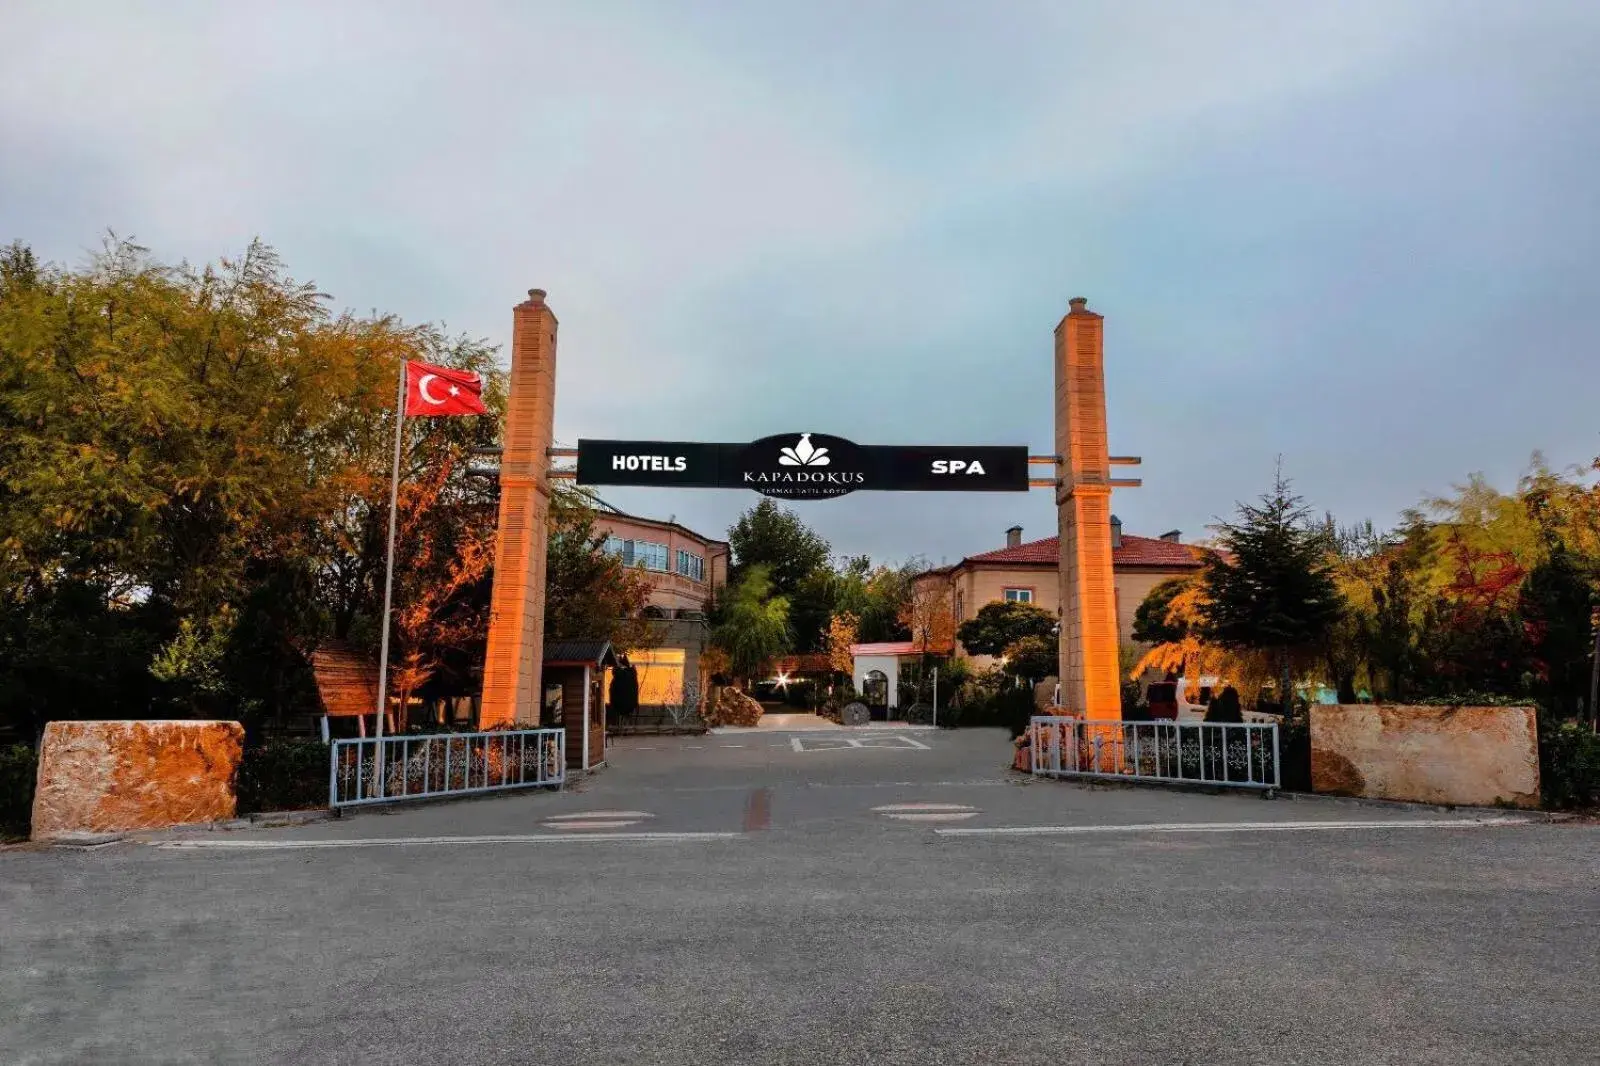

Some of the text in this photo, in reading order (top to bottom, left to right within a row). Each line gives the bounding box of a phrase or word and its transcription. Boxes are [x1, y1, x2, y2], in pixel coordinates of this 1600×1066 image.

[612, 455, 687, 472] HOTELS
[931, 460, 986, 475] SPA
[743, 471, 865, 485] KAPADOKUS
